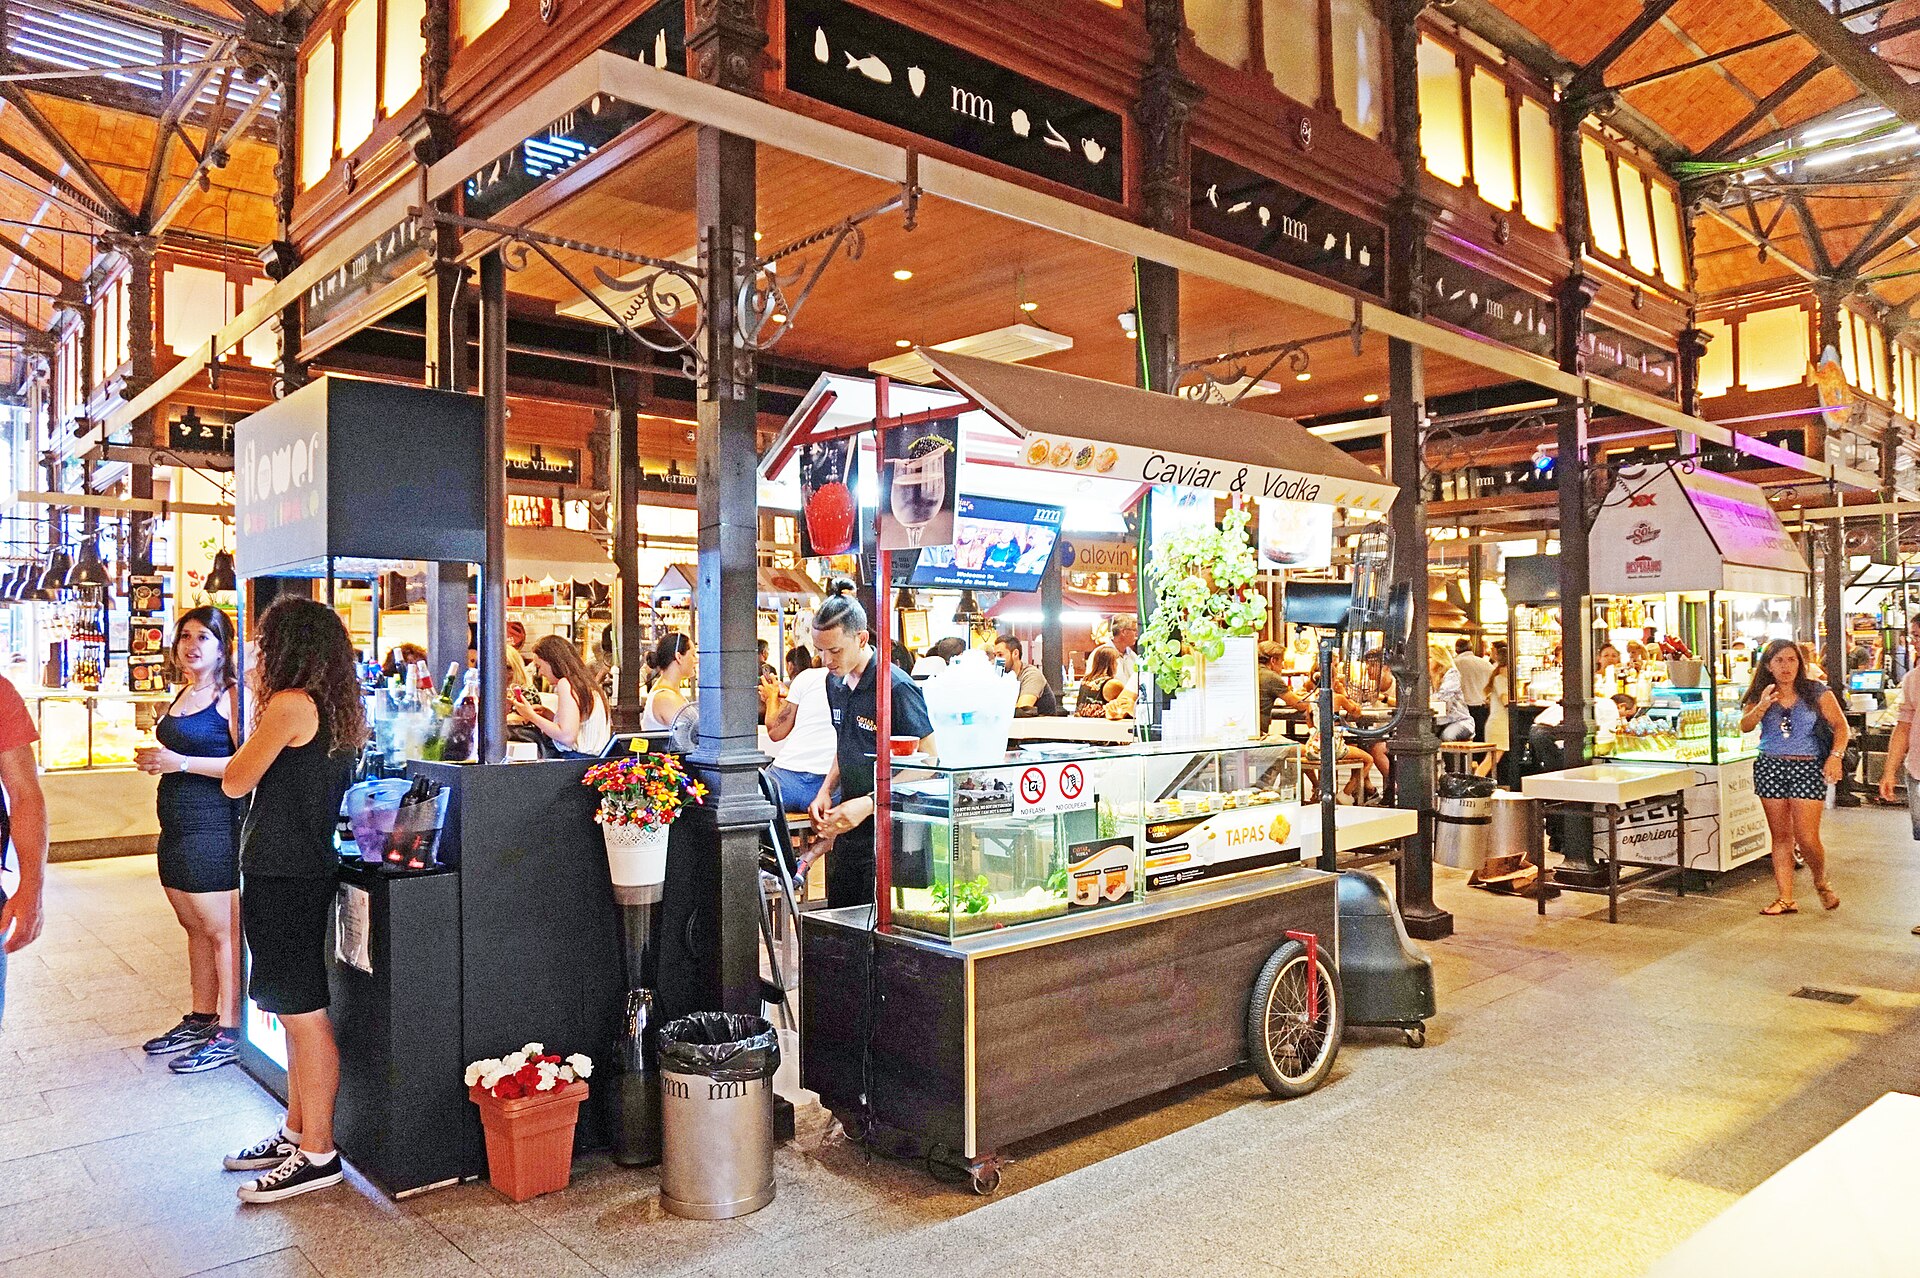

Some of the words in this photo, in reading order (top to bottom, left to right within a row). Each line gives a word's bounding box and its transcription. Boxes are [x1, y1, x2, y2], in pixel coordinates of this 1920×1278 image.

[532, 457, 562, 472] vino
[1142, 454, 1221, 489] Caviar
[1230, 467, 1248, 492] &
[1263, 472, 1321, 501] Vodka
[1080, 544, 1129, 566] alevín
[957, 571, 986, 579] Welcome
[1020, 808, 1029, 816] NO
[1029, 807, 1046, 815] FLASH
[1064, 801, 1087, 811] GOLPEAR
[1226, 825, 1265, 846] TAPAS
